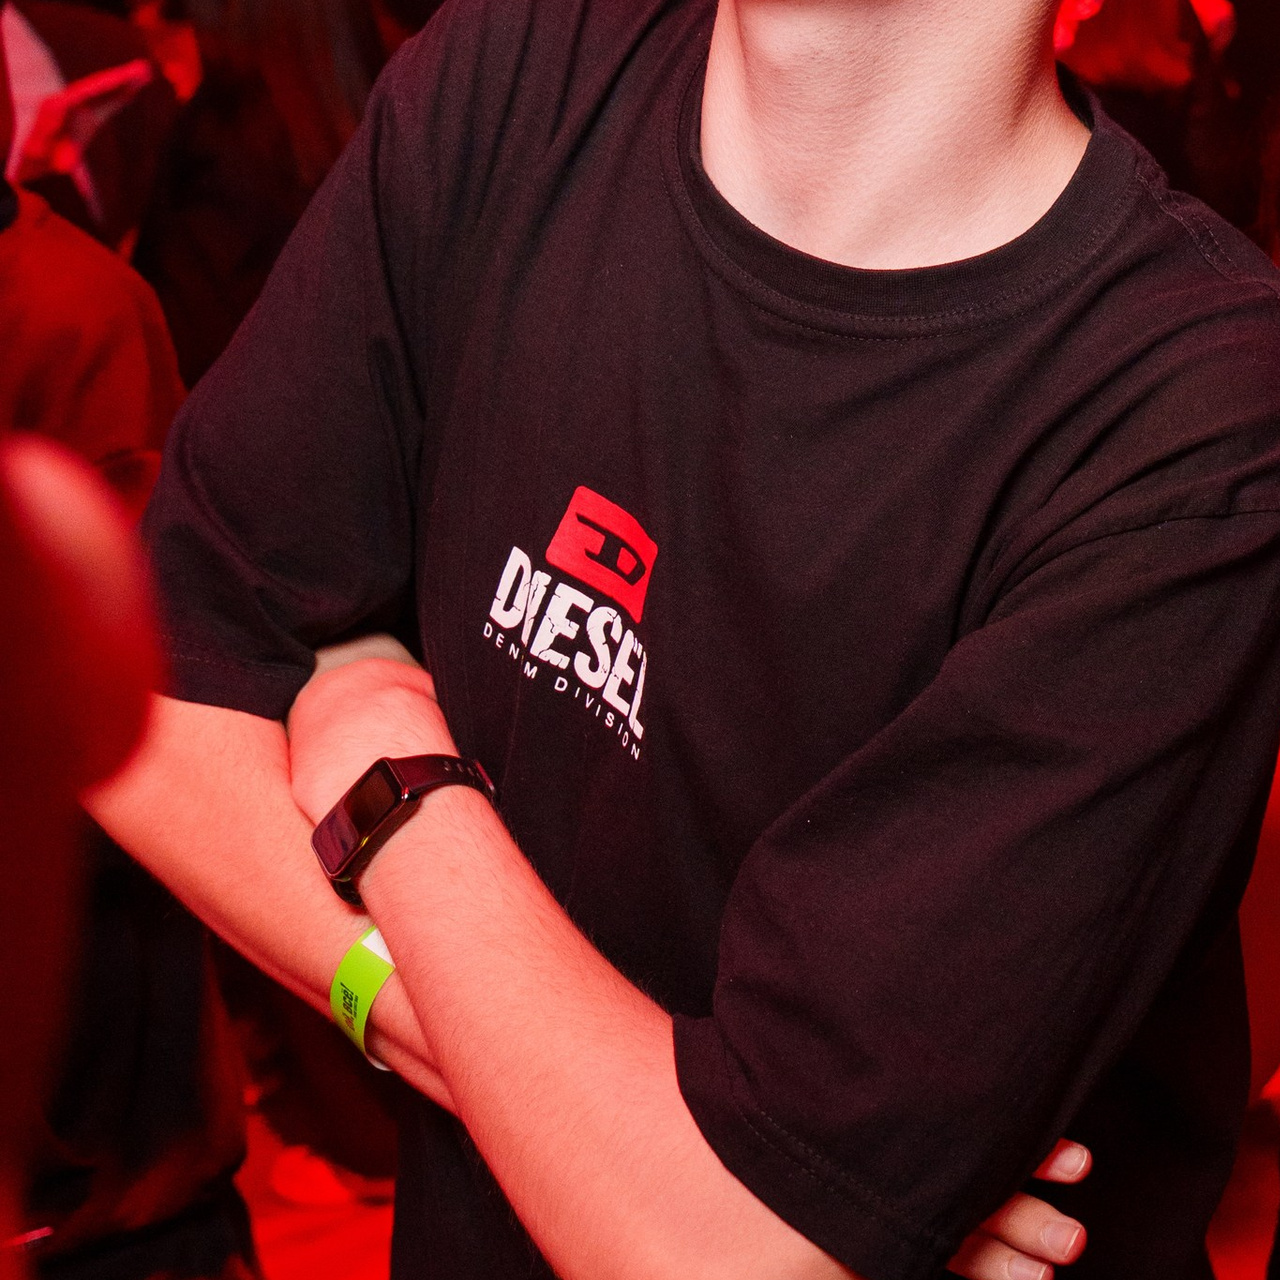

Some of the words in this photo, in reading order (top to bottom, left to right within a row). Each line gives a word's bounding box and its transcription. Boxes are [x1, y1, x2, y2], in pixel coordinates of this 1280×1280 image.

[483, 622, 538, 679] DENM
[554, 676, 640, 761] DIVISION
[489, 545, 647, 740] DIESEL
